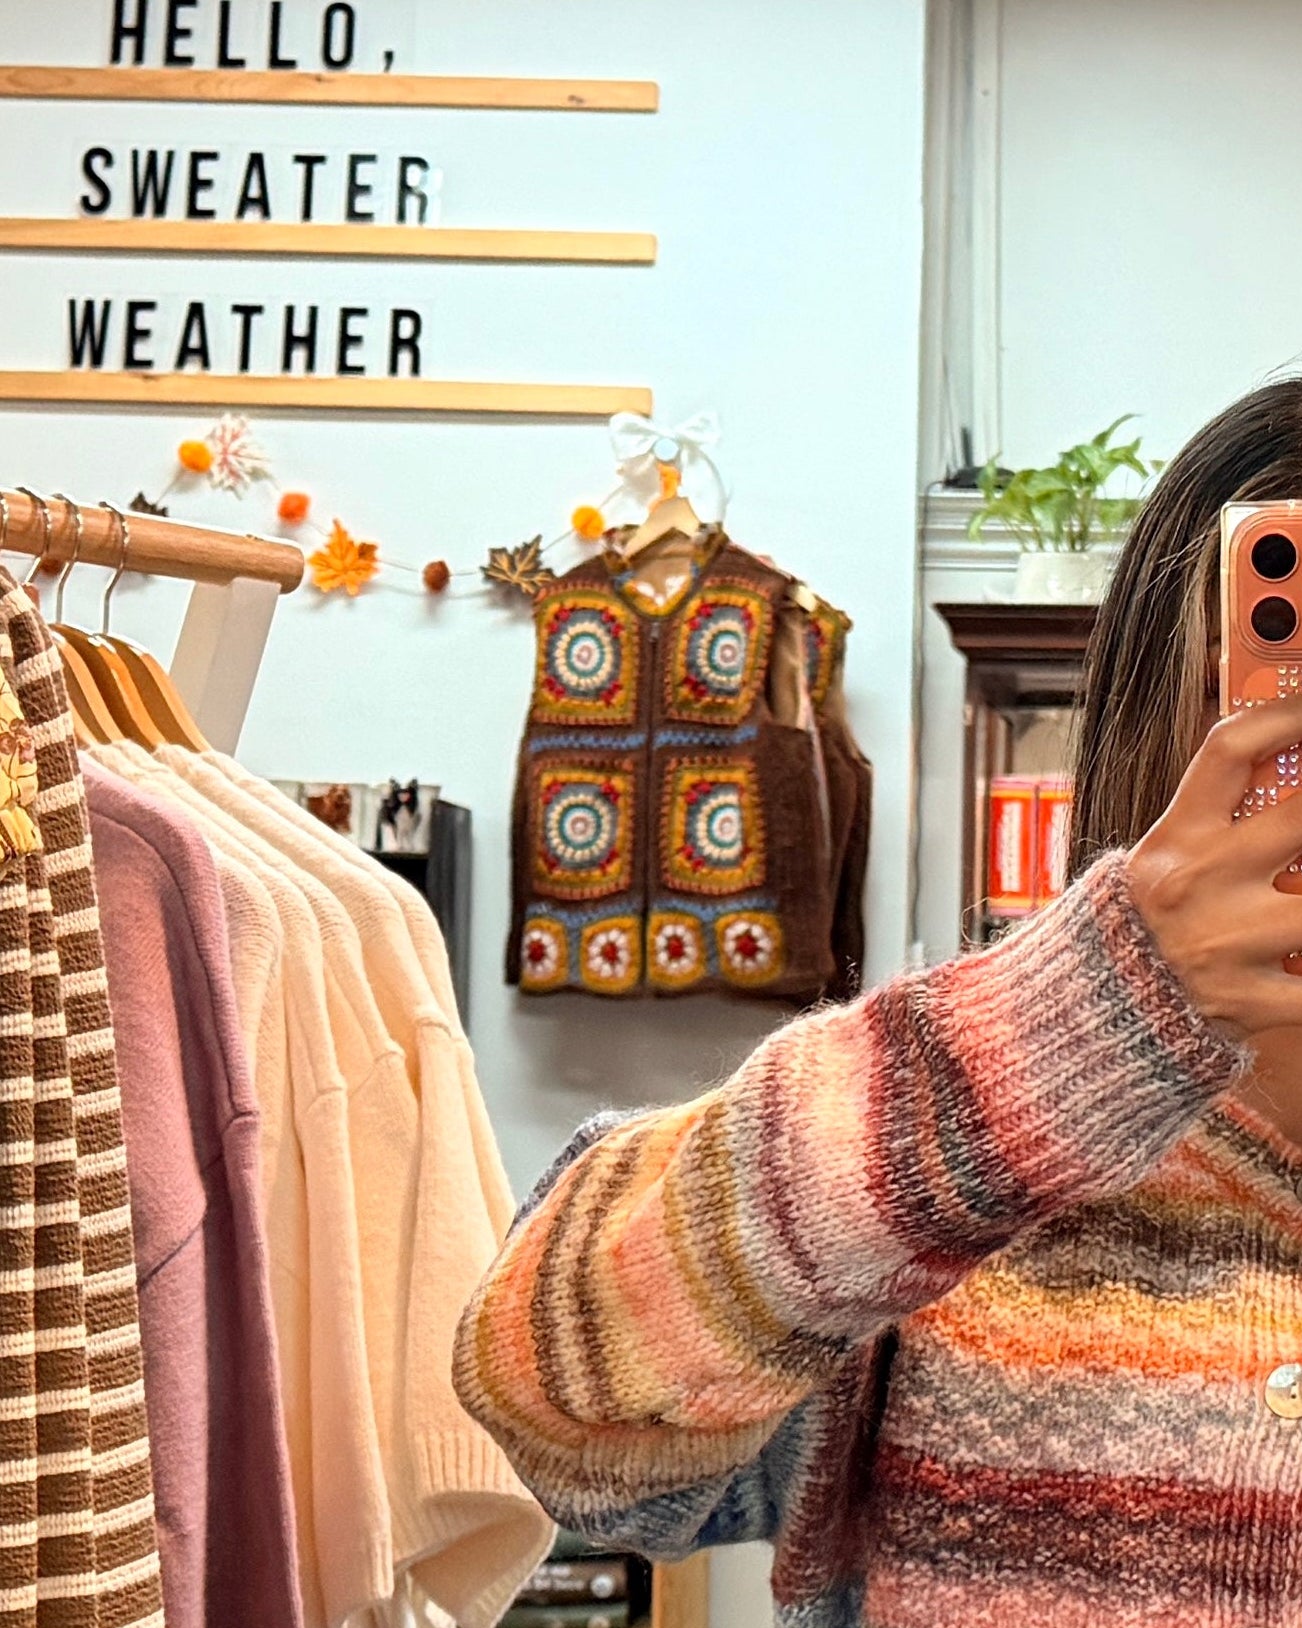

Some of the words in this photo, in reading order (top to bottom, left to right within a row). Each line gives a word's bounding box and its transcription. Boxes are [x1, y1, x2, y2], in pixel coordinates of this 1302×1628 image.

[111, 0, 395, 71] HELLO,
[80, 147, 430, 224] SWEATER
[67, 299, 424, 376] WEATHER
